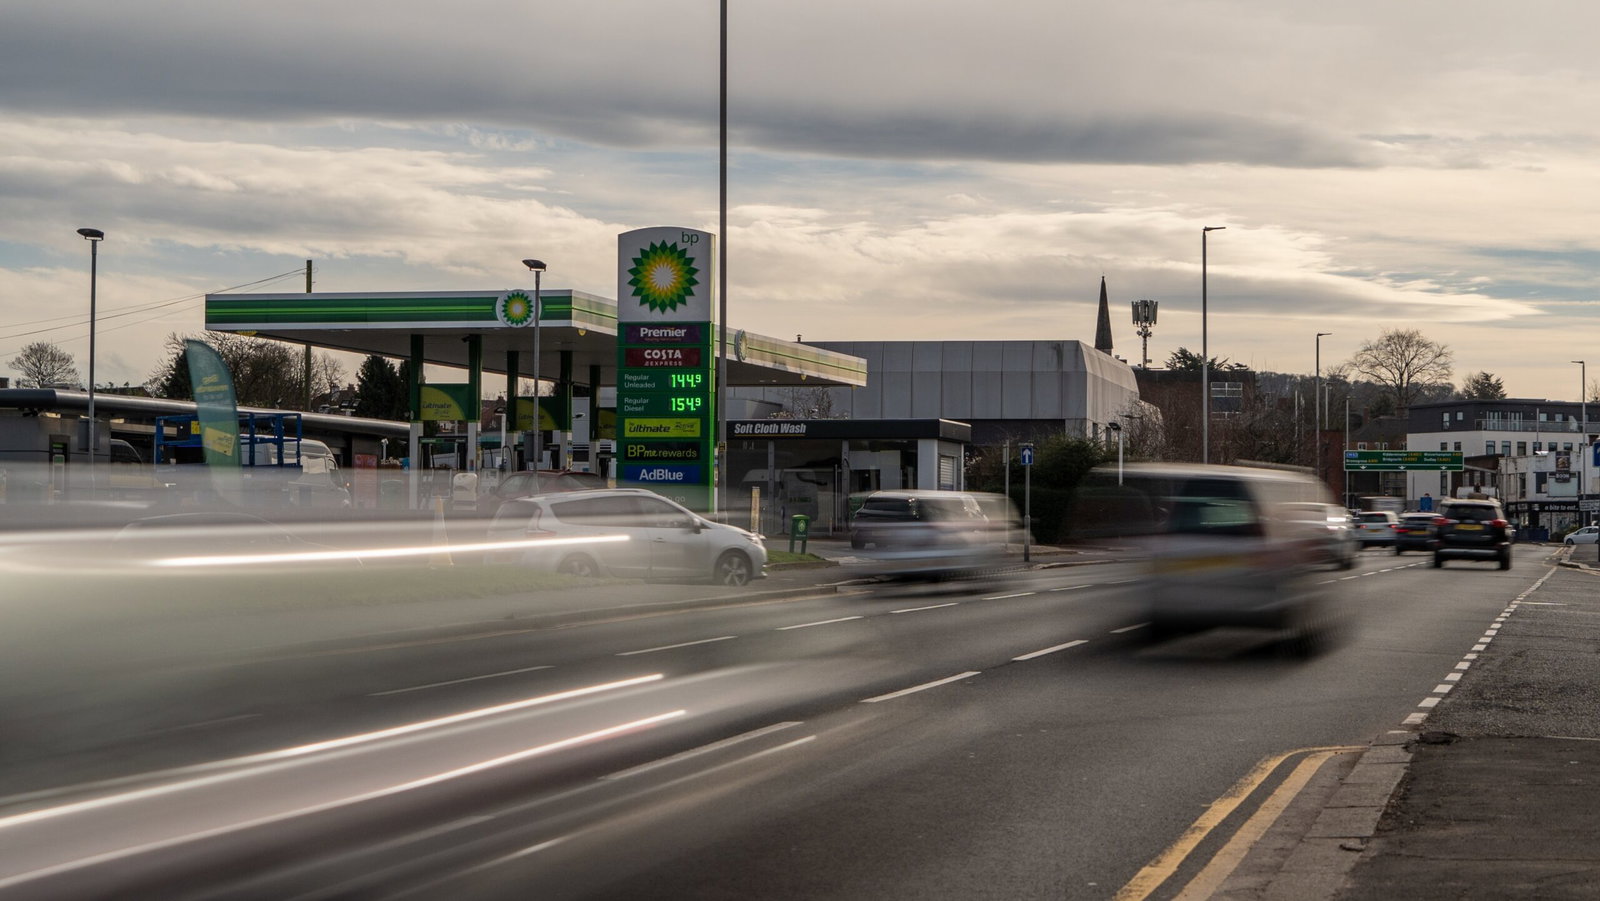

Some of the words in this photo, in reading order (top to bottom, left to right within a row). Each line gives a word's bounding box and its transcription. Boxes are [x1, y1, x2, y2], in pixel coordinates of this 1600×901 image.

[681, 231, 699, 246] bp
[640, 327, 687, 337] Premier
[644, 349, 682, 360] COSTA
[671, 374, 702, 388] 144.9
[671, 397, 702, 411] 154.9
[629, 423, 671, 433] ultimate
[734, 423, 753, 434] Soft
[754, 423, 779, 434] Cloth
[780, 423, 807, 434] Wash
[658, 448, 697, 458] rewards
[639, 468, 684, 480] AdBlue
